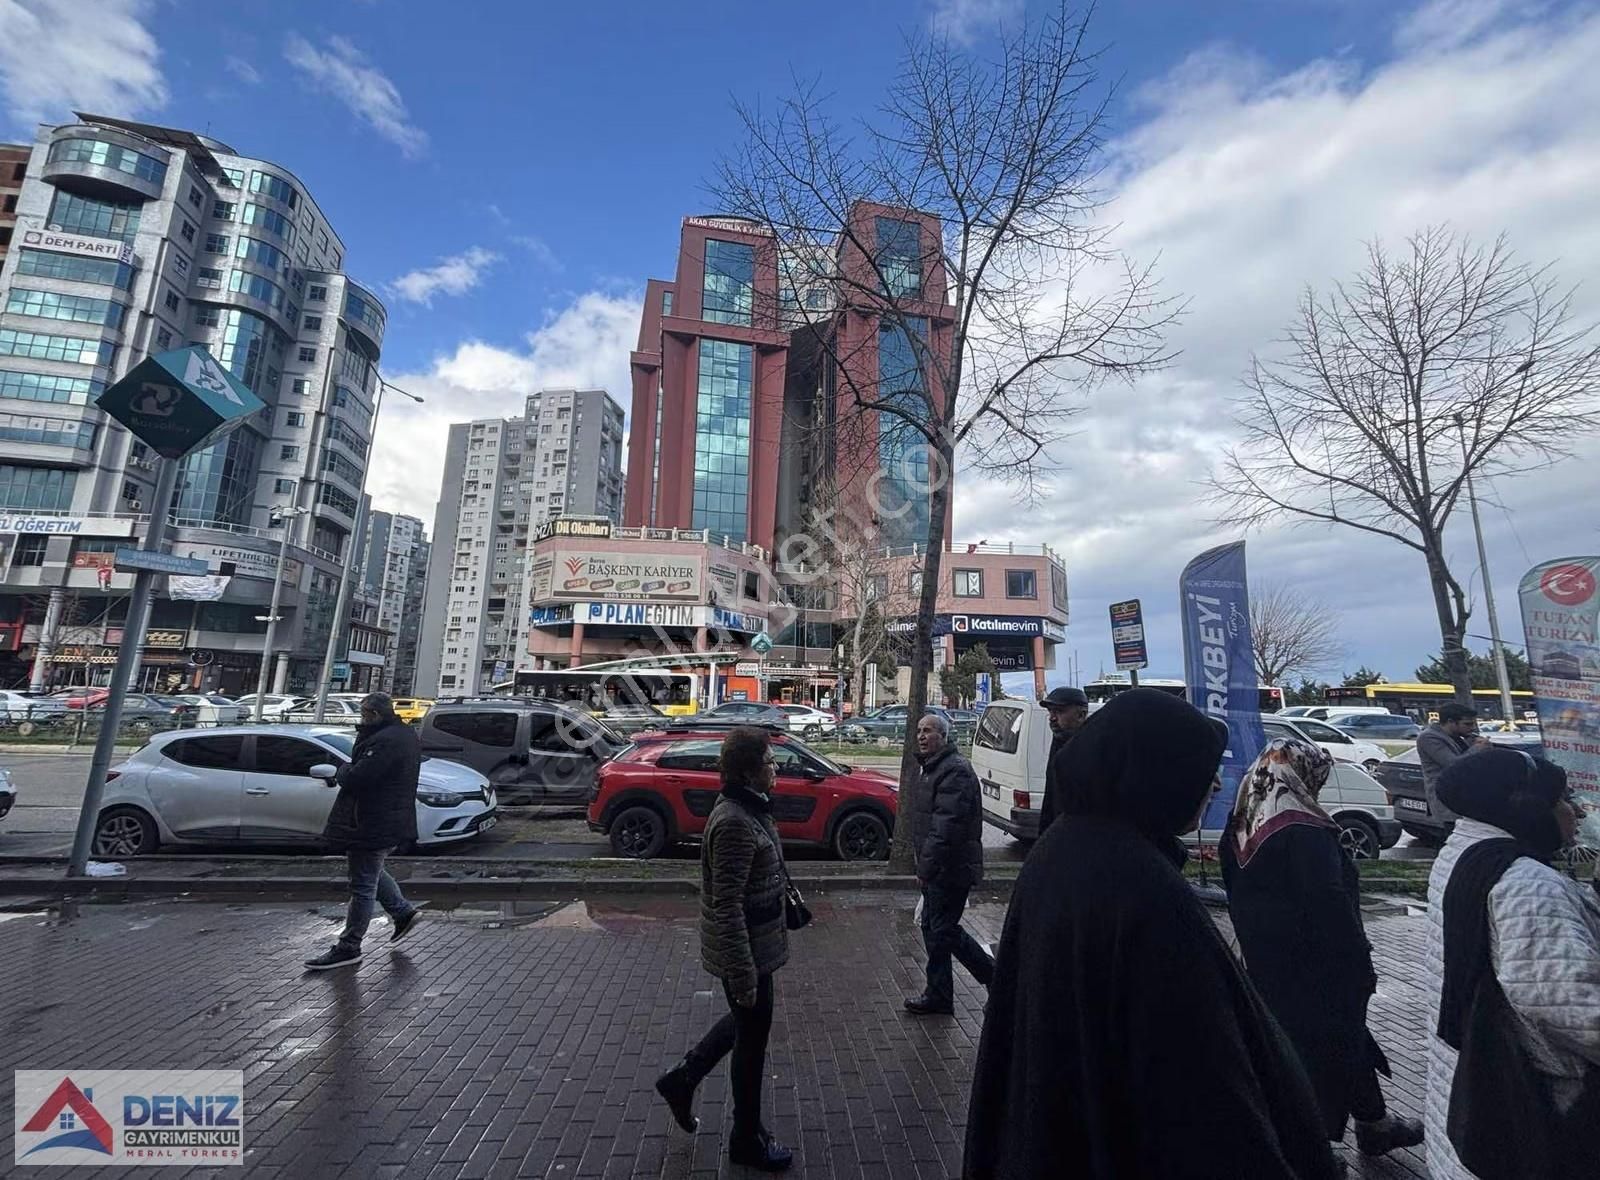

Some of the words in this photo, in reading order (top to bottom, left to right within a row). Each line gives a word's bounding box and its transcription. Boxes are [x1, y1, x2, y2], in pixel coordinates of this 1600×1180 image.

[45, 236, 75, 249] DEM
[76, 241, 118, 254] PARTİ
[14, 517, 82, 533] ÖĞRETİM
[556, 521, 570, 534] Dil
[570, 521, 608, 535] Okulları
[588, 564, 642, 577] BAŞKENT
[643, 564, 694, 578] KARİYER
[971, 618, 1039, 631] Katılımevim
[1531, 609, 1592, 626] TUTAN
[1527, 626, 1596, 645] TURİZM
